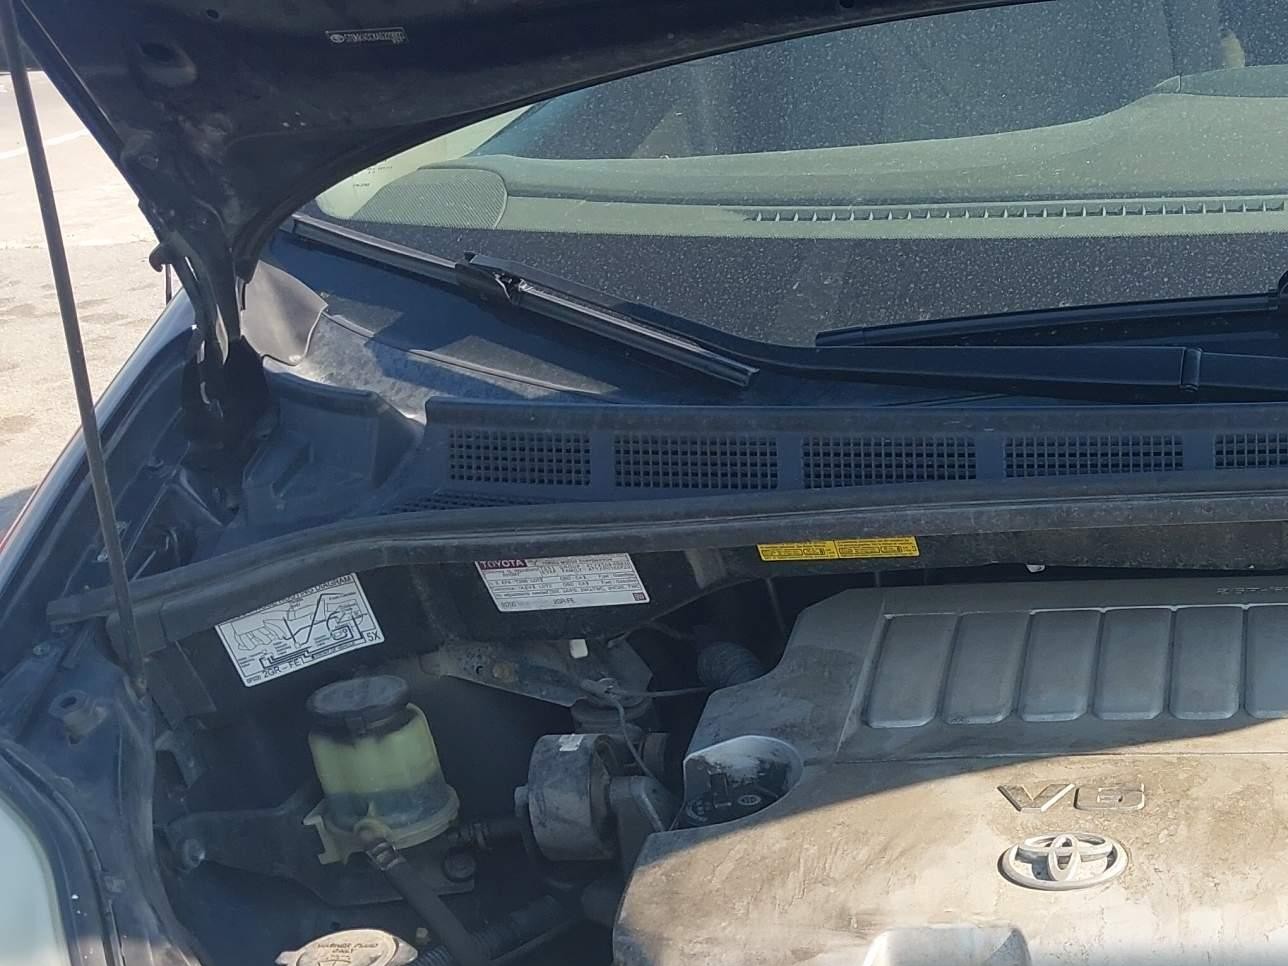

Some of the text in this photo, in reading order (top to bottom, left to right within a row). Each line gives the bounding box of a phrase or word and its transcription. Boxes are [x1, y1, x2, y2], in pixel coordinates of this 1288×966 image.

[480, 559, 525, 569] TOYOTA
[367, 630, 382, 643] 5X
[997, 783, 1146, 812] V6
